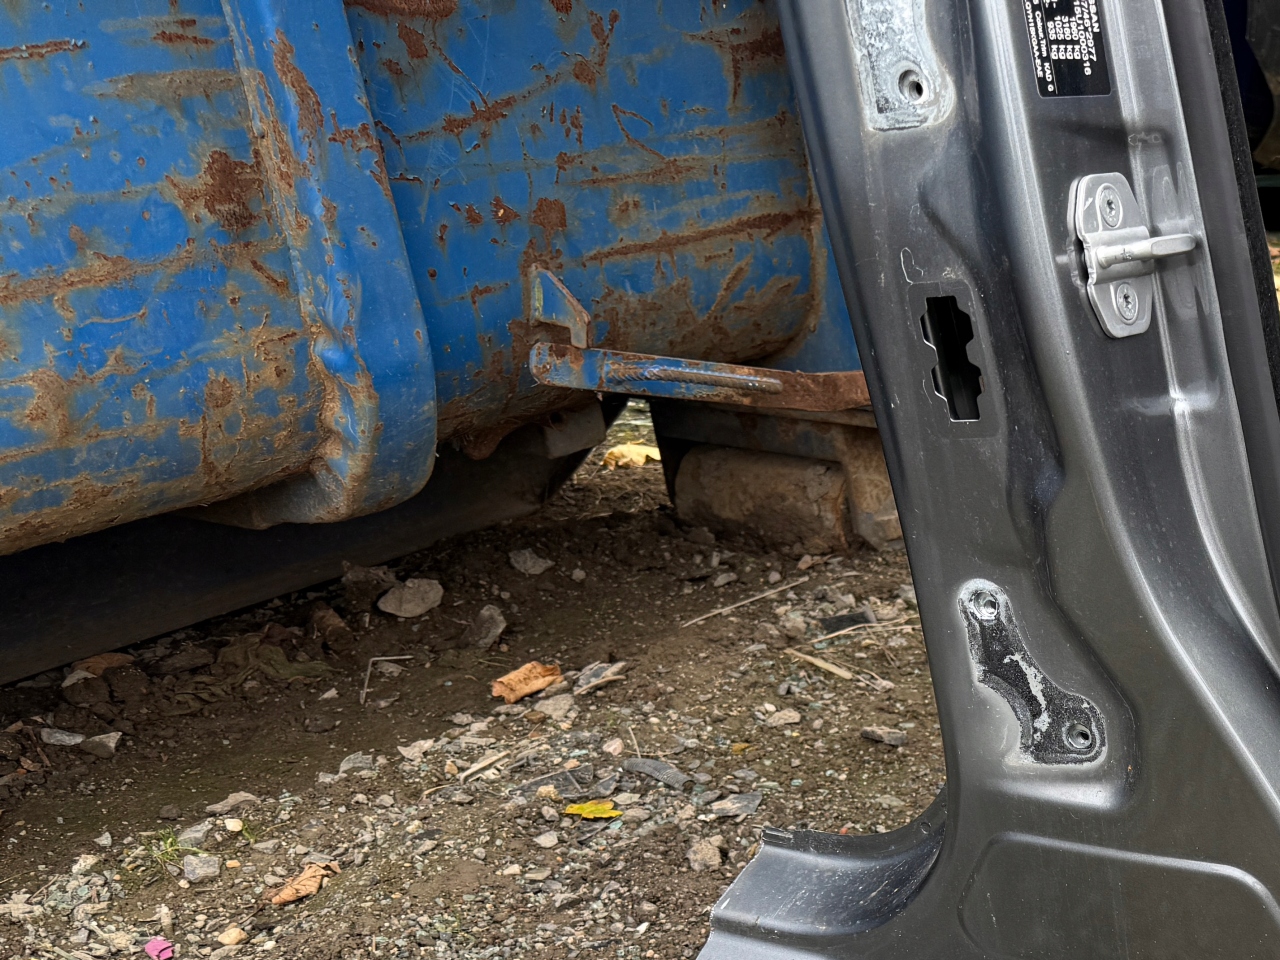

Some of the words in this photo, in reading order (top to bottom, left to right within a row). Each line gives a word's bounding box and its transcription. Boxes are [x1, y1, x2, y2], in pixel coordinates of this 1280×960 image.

[1047, 20, 1057, 41] 935
[1054, 15, 1065, 41] 1025
[1051, 44, 1059, 60] kg
[1058, 44, 1066, 60] kg
[1066, 44, 1074, 60] kg
[1073, 44, 1081, 60] kg
